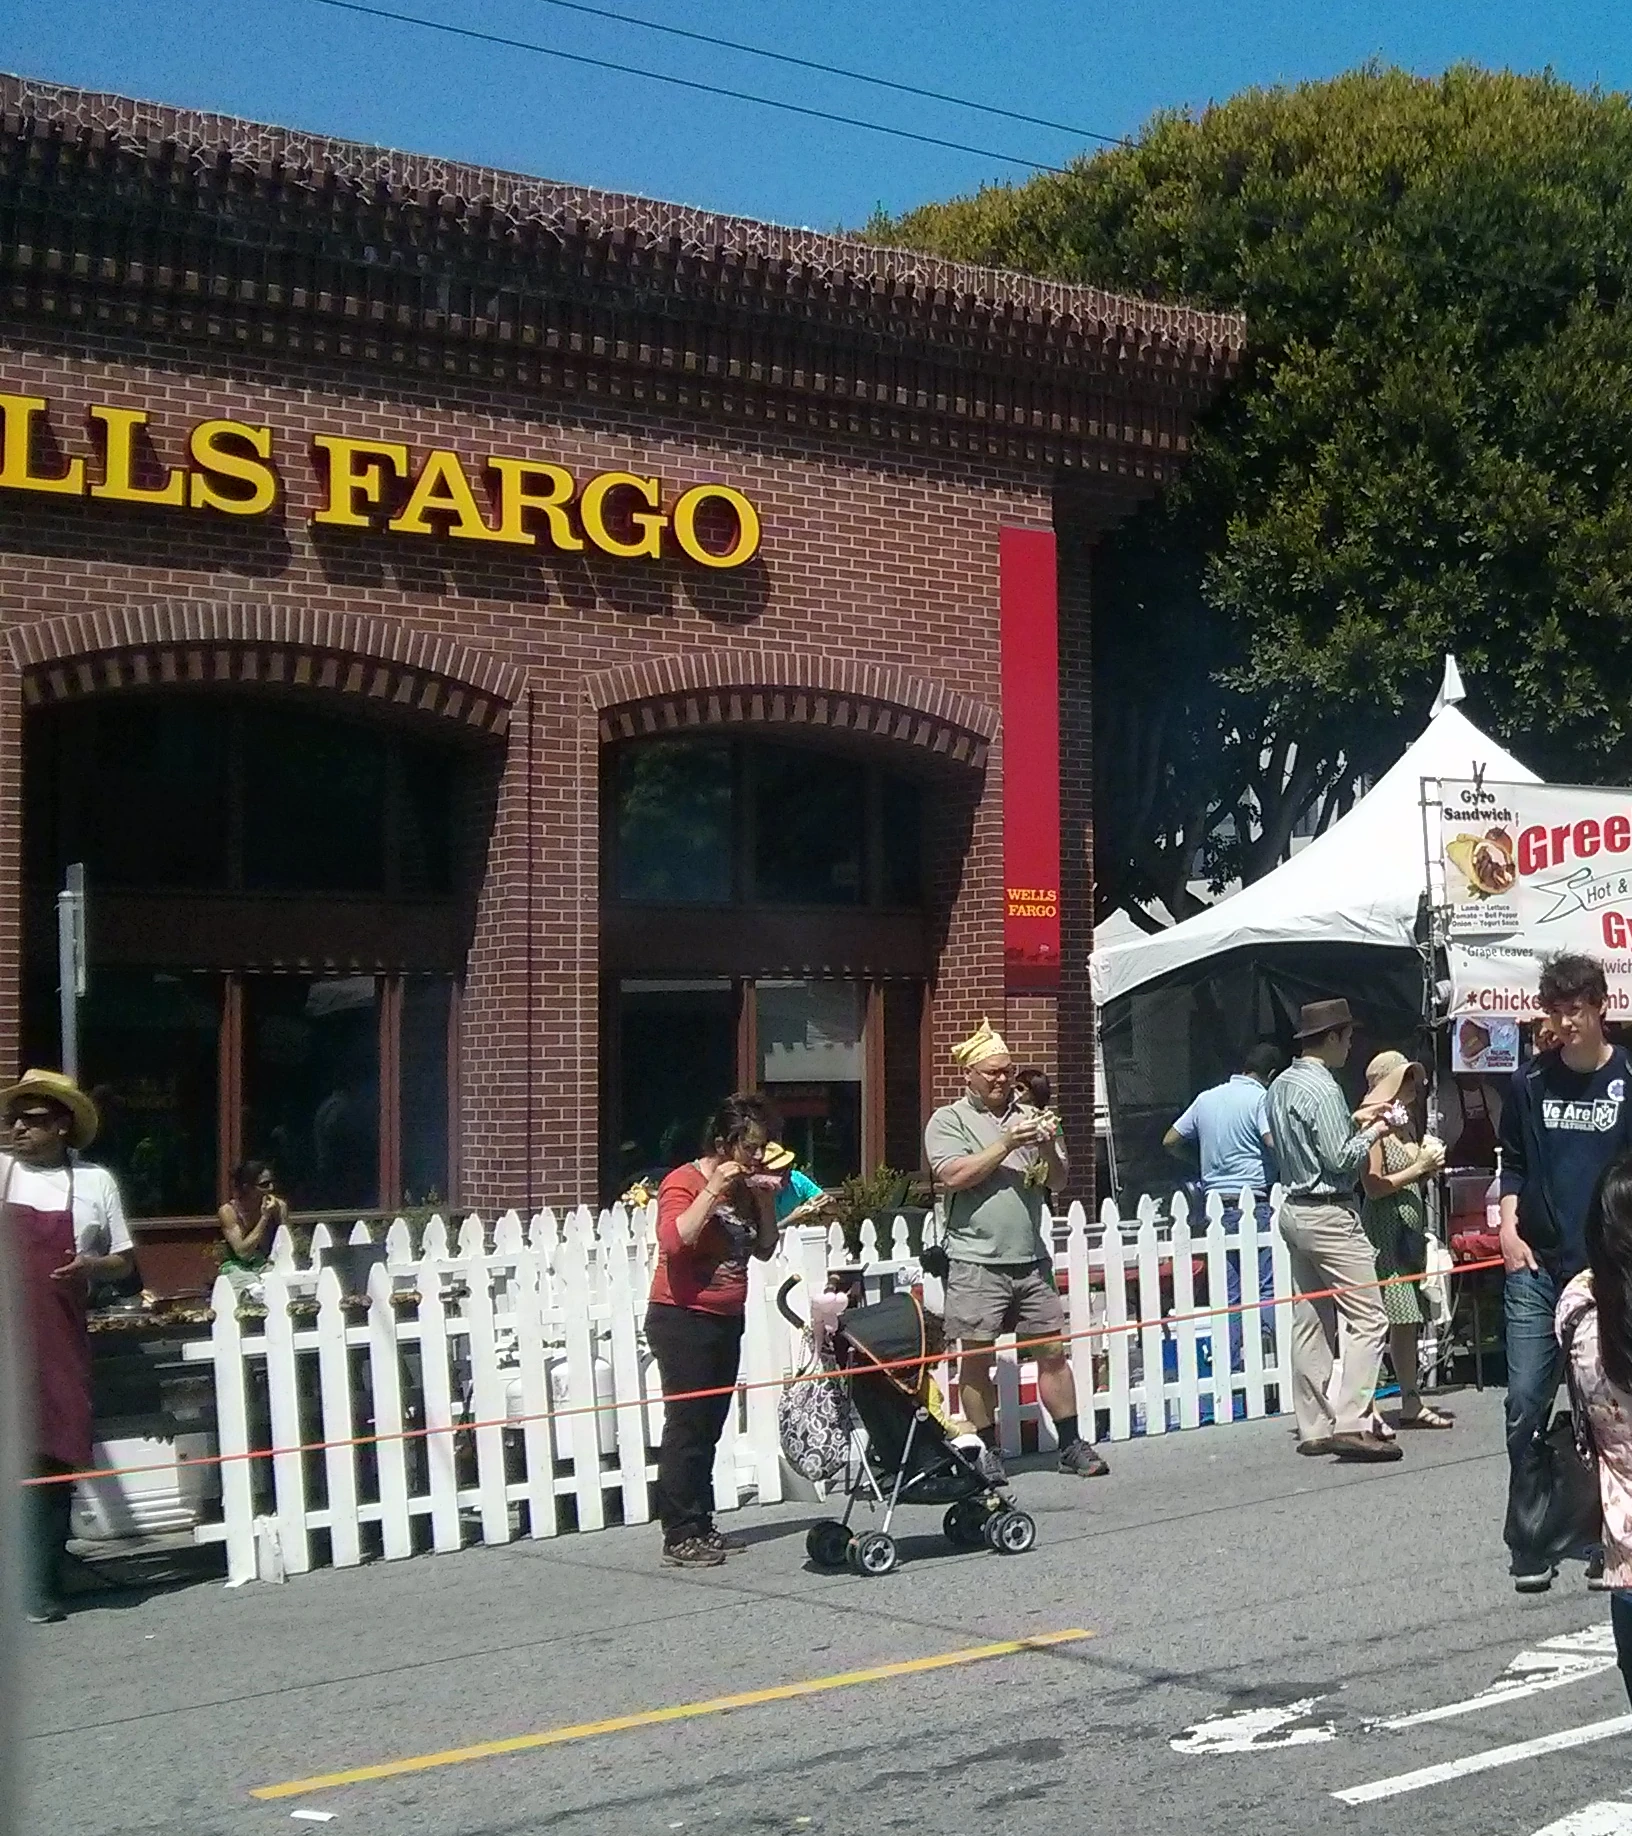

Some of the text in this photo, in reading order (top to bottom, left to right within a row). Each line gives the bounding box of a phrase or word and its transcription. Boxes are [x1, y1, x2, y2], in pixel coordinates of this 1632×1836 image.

[0, 394, 762, 569] LLS FARGO
[1461, 790, 1495, 807] Gyro
[1444, 807, 1512, 822] Sandwich
[1006, 888, 1057, 902] WELLS
[1586, 880, 1612, 904] Hot
[1617, 880, 1628, 894] &
[1008, 904, 1057, 918] FARGO
[1460, 904, 1480, 912] Lamb
[1467, 945, 1534, 960] Grape Leaves
[1479, 987, 1542, 1011] Chicke
[1607, 987, 1630, 1009] mb
[1563, 1103, 1591, 1121] Are
